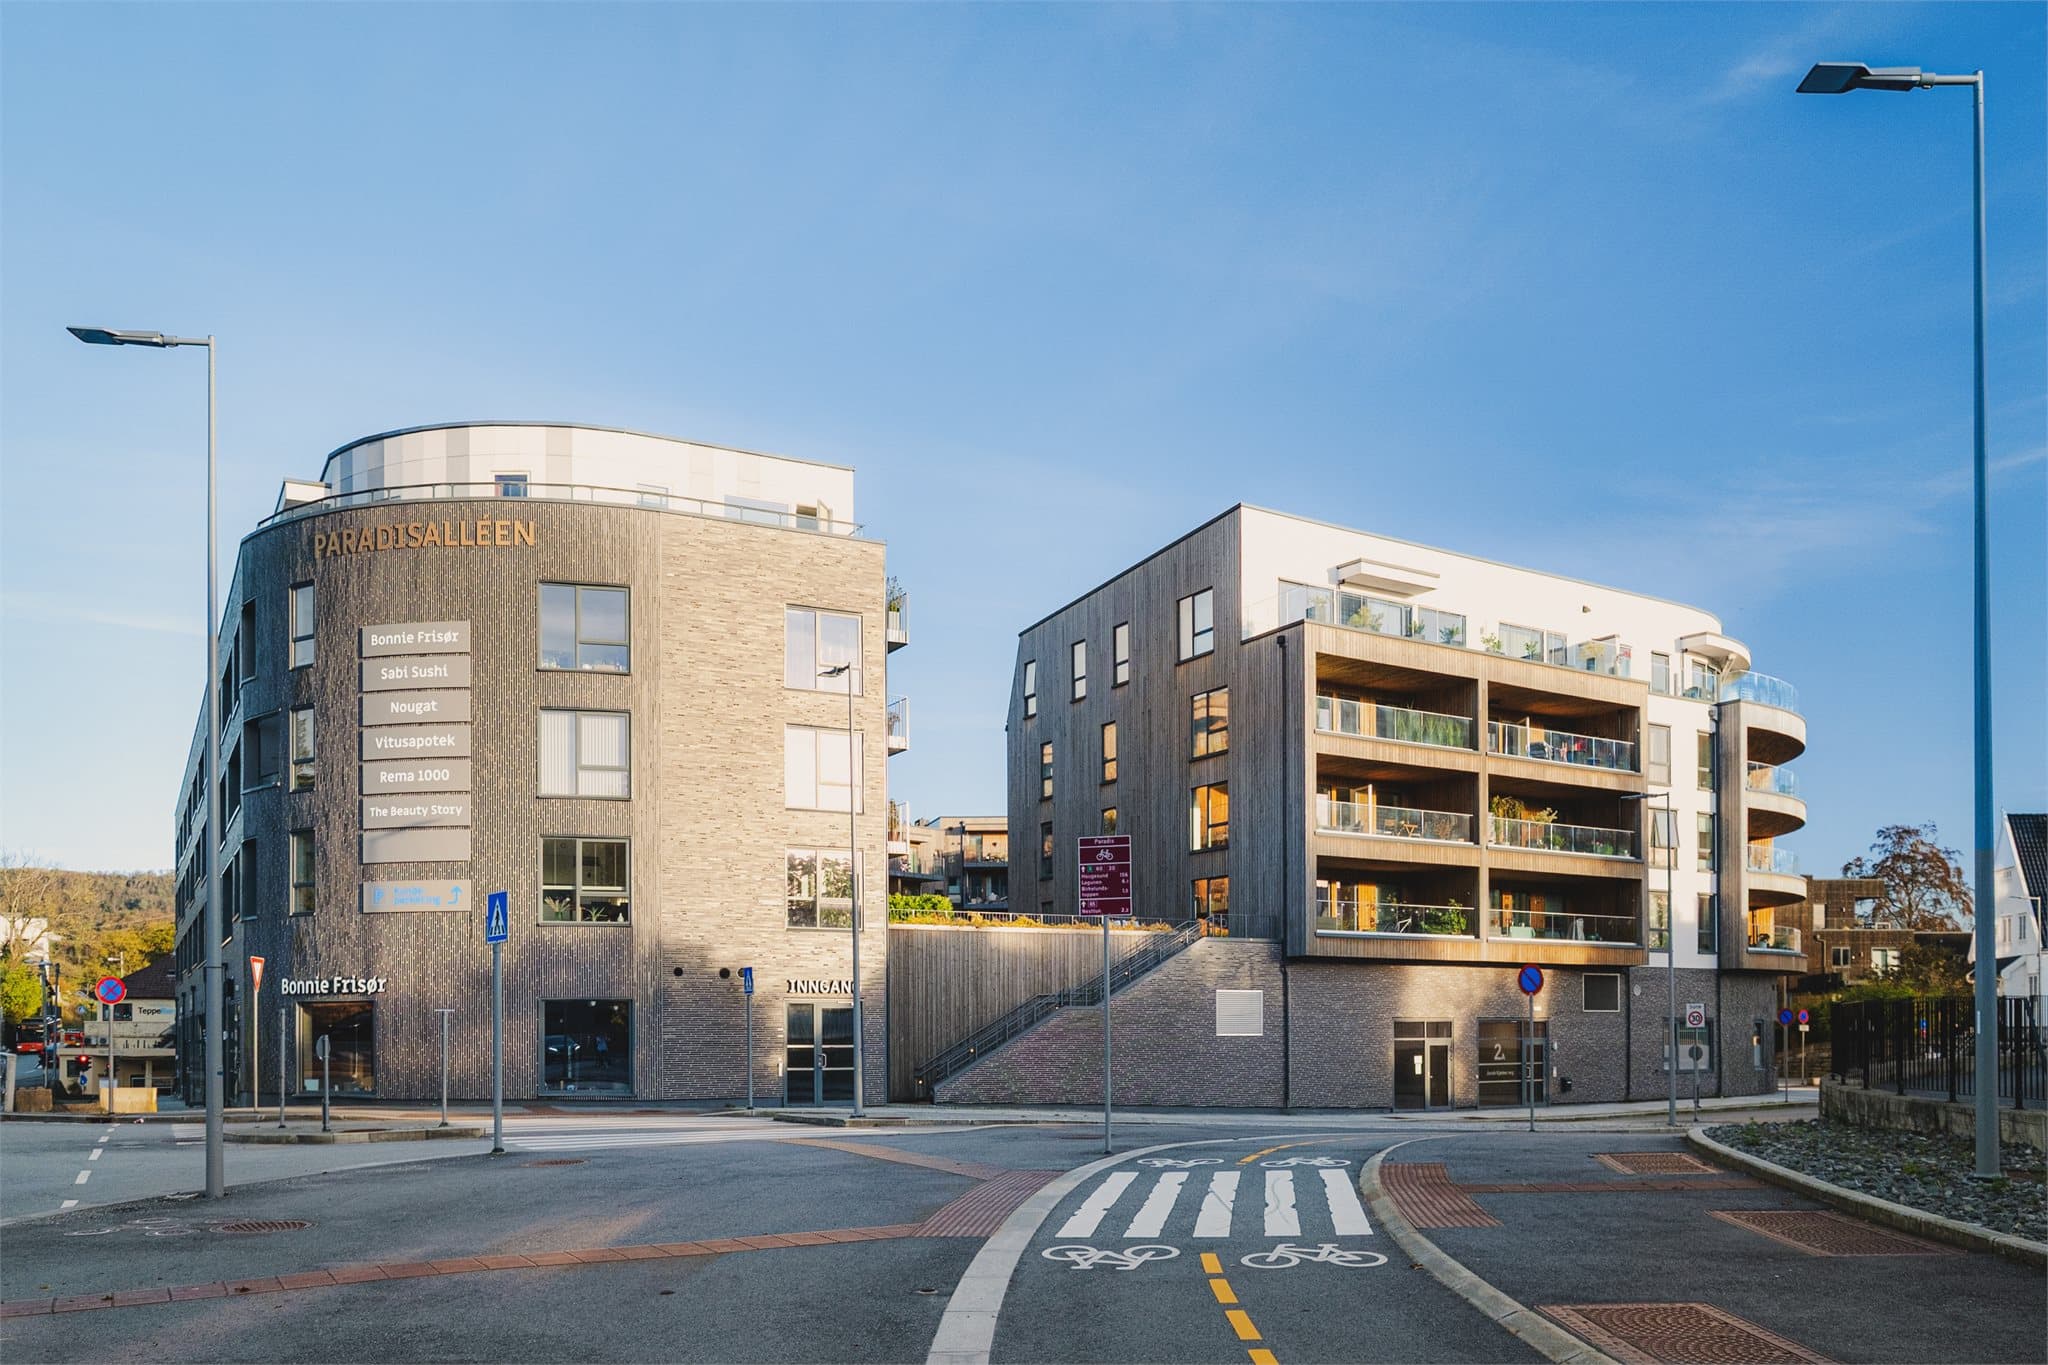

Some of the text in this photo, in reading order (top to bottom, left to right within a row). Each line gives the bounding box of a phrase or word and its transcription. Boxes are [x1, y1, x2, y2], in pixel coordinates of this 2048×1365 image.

[314, 514, 536, 559] PARADISALLÉEN
[371, 629, 459, 646] Bonnie Frisør
[381, 664, 448, 680] Sabi Sushi
[390, 700, 438, 715] Nougat
[375, 734, 456, 749] Vitusapotek
[380, 769, 450, 783] Rema 1000
[370, 804, 463, 817] The Beauty Story
[281, 975, 387, 995] Bonnie Frisør
[1691, 1014, 1700, 1022] 30
